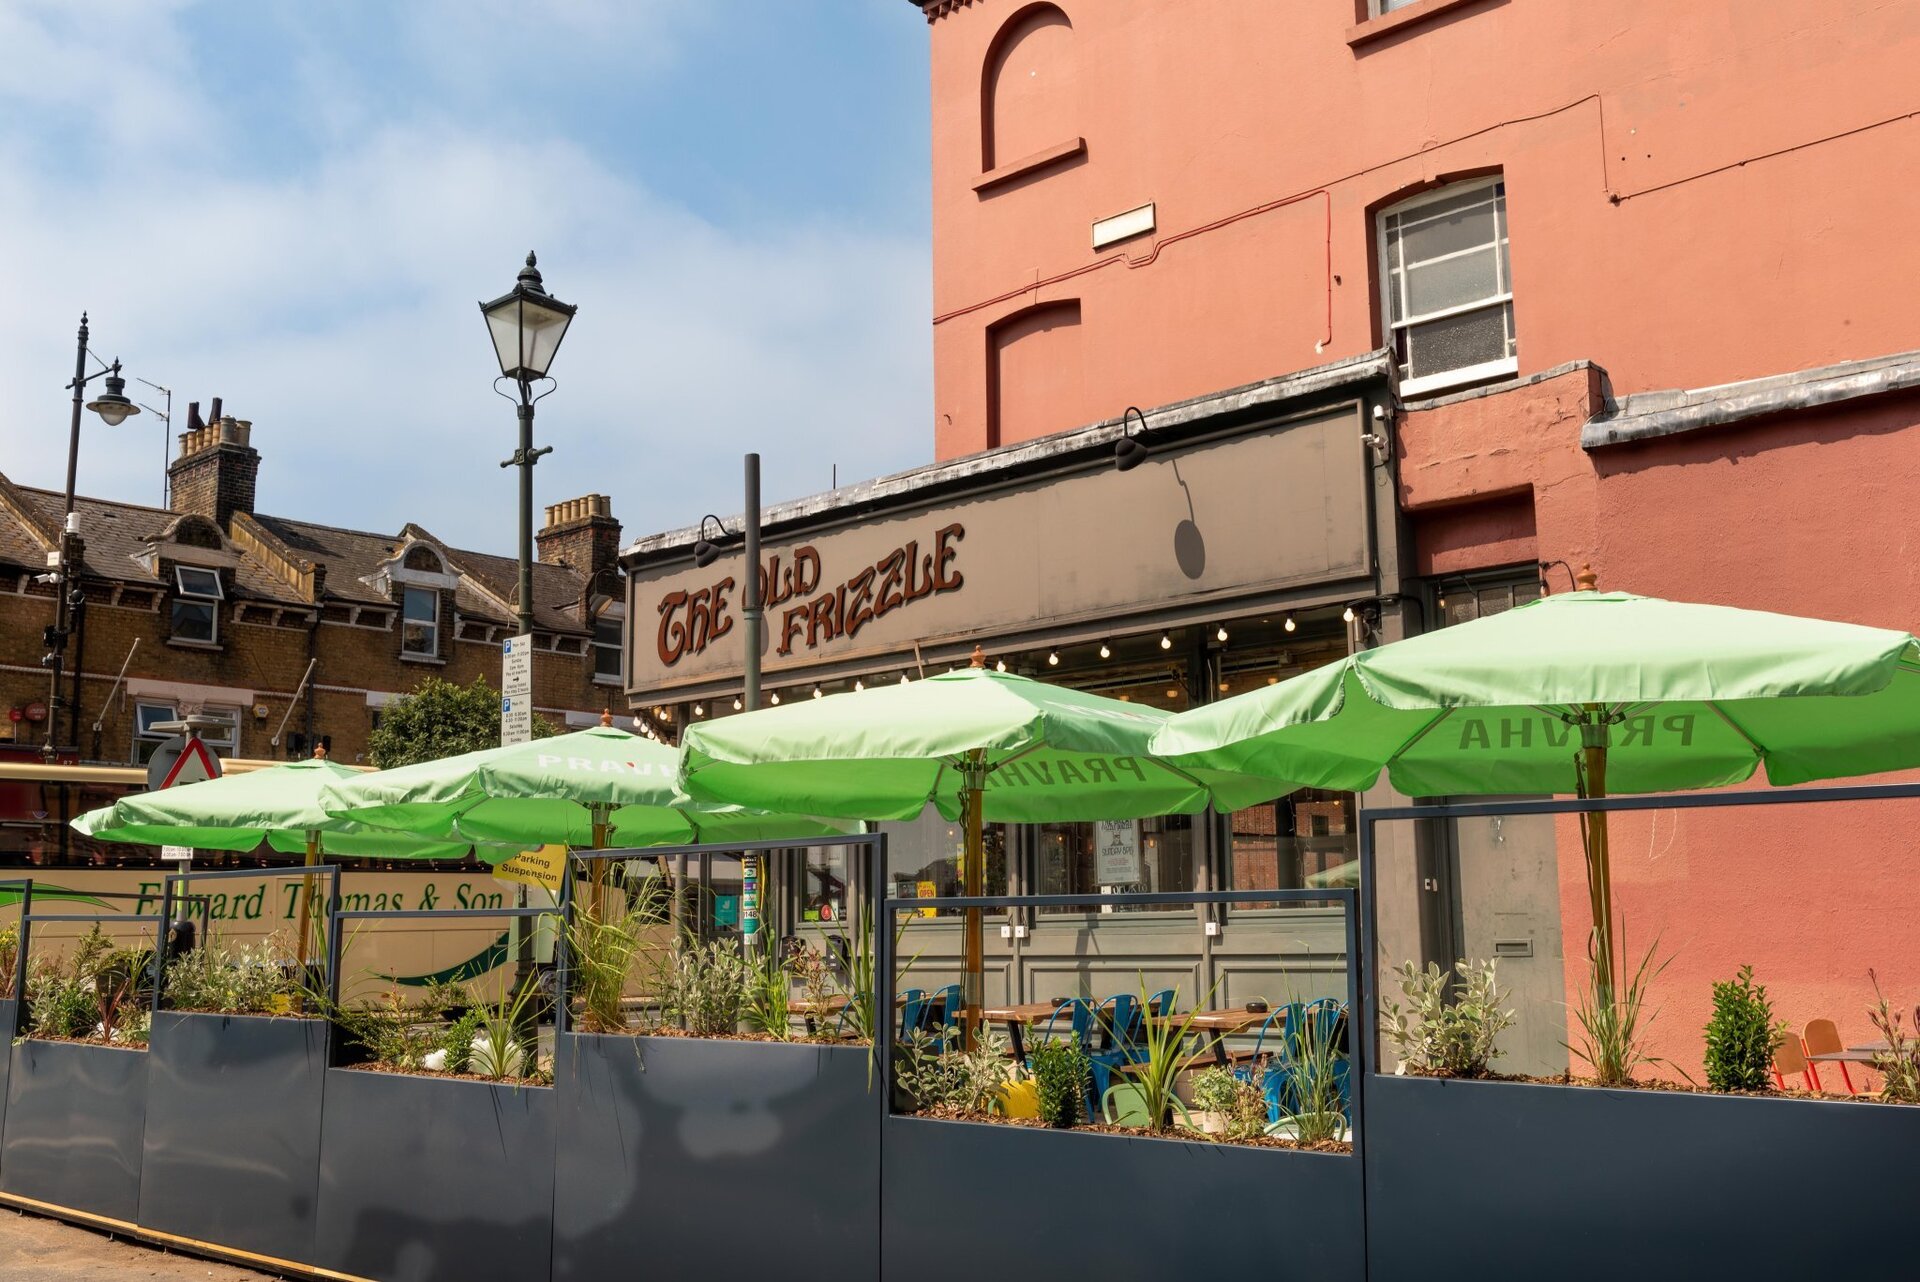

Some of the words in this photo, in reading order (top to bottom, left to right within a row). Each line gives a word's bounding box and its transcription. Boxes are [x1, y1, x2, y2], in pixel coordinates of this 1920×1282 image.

[776, 523, 965, 656] FRIZZLE
[502, 863, 557, 882] Suspension
[514, 854, 550, 869] Parking
[418, 884, 440, 910] &
[454, 884, 502, 910] Son
